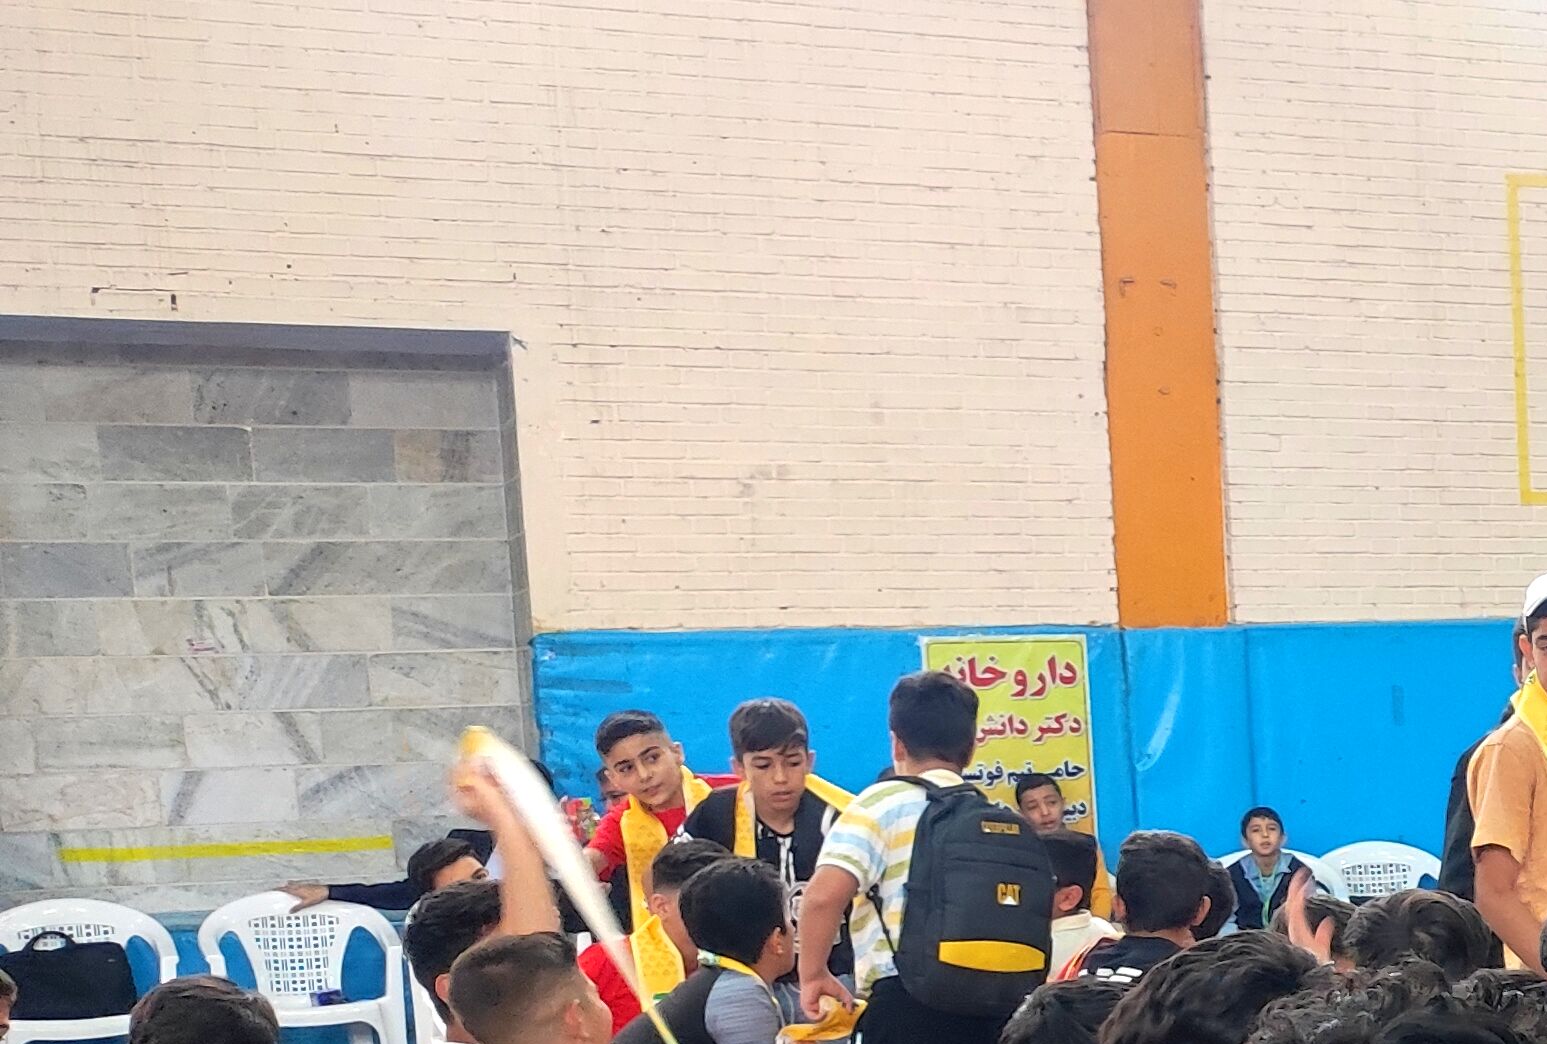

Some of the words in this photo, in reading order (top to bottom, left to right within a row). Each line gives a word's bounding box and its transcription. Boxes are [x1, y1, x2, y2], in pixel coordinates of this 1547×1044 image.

[943, 655, 1078, 698] داروخان
[1033, 713, 1082, 742] دکتر
[1043, 760, 1085, 780] حام
